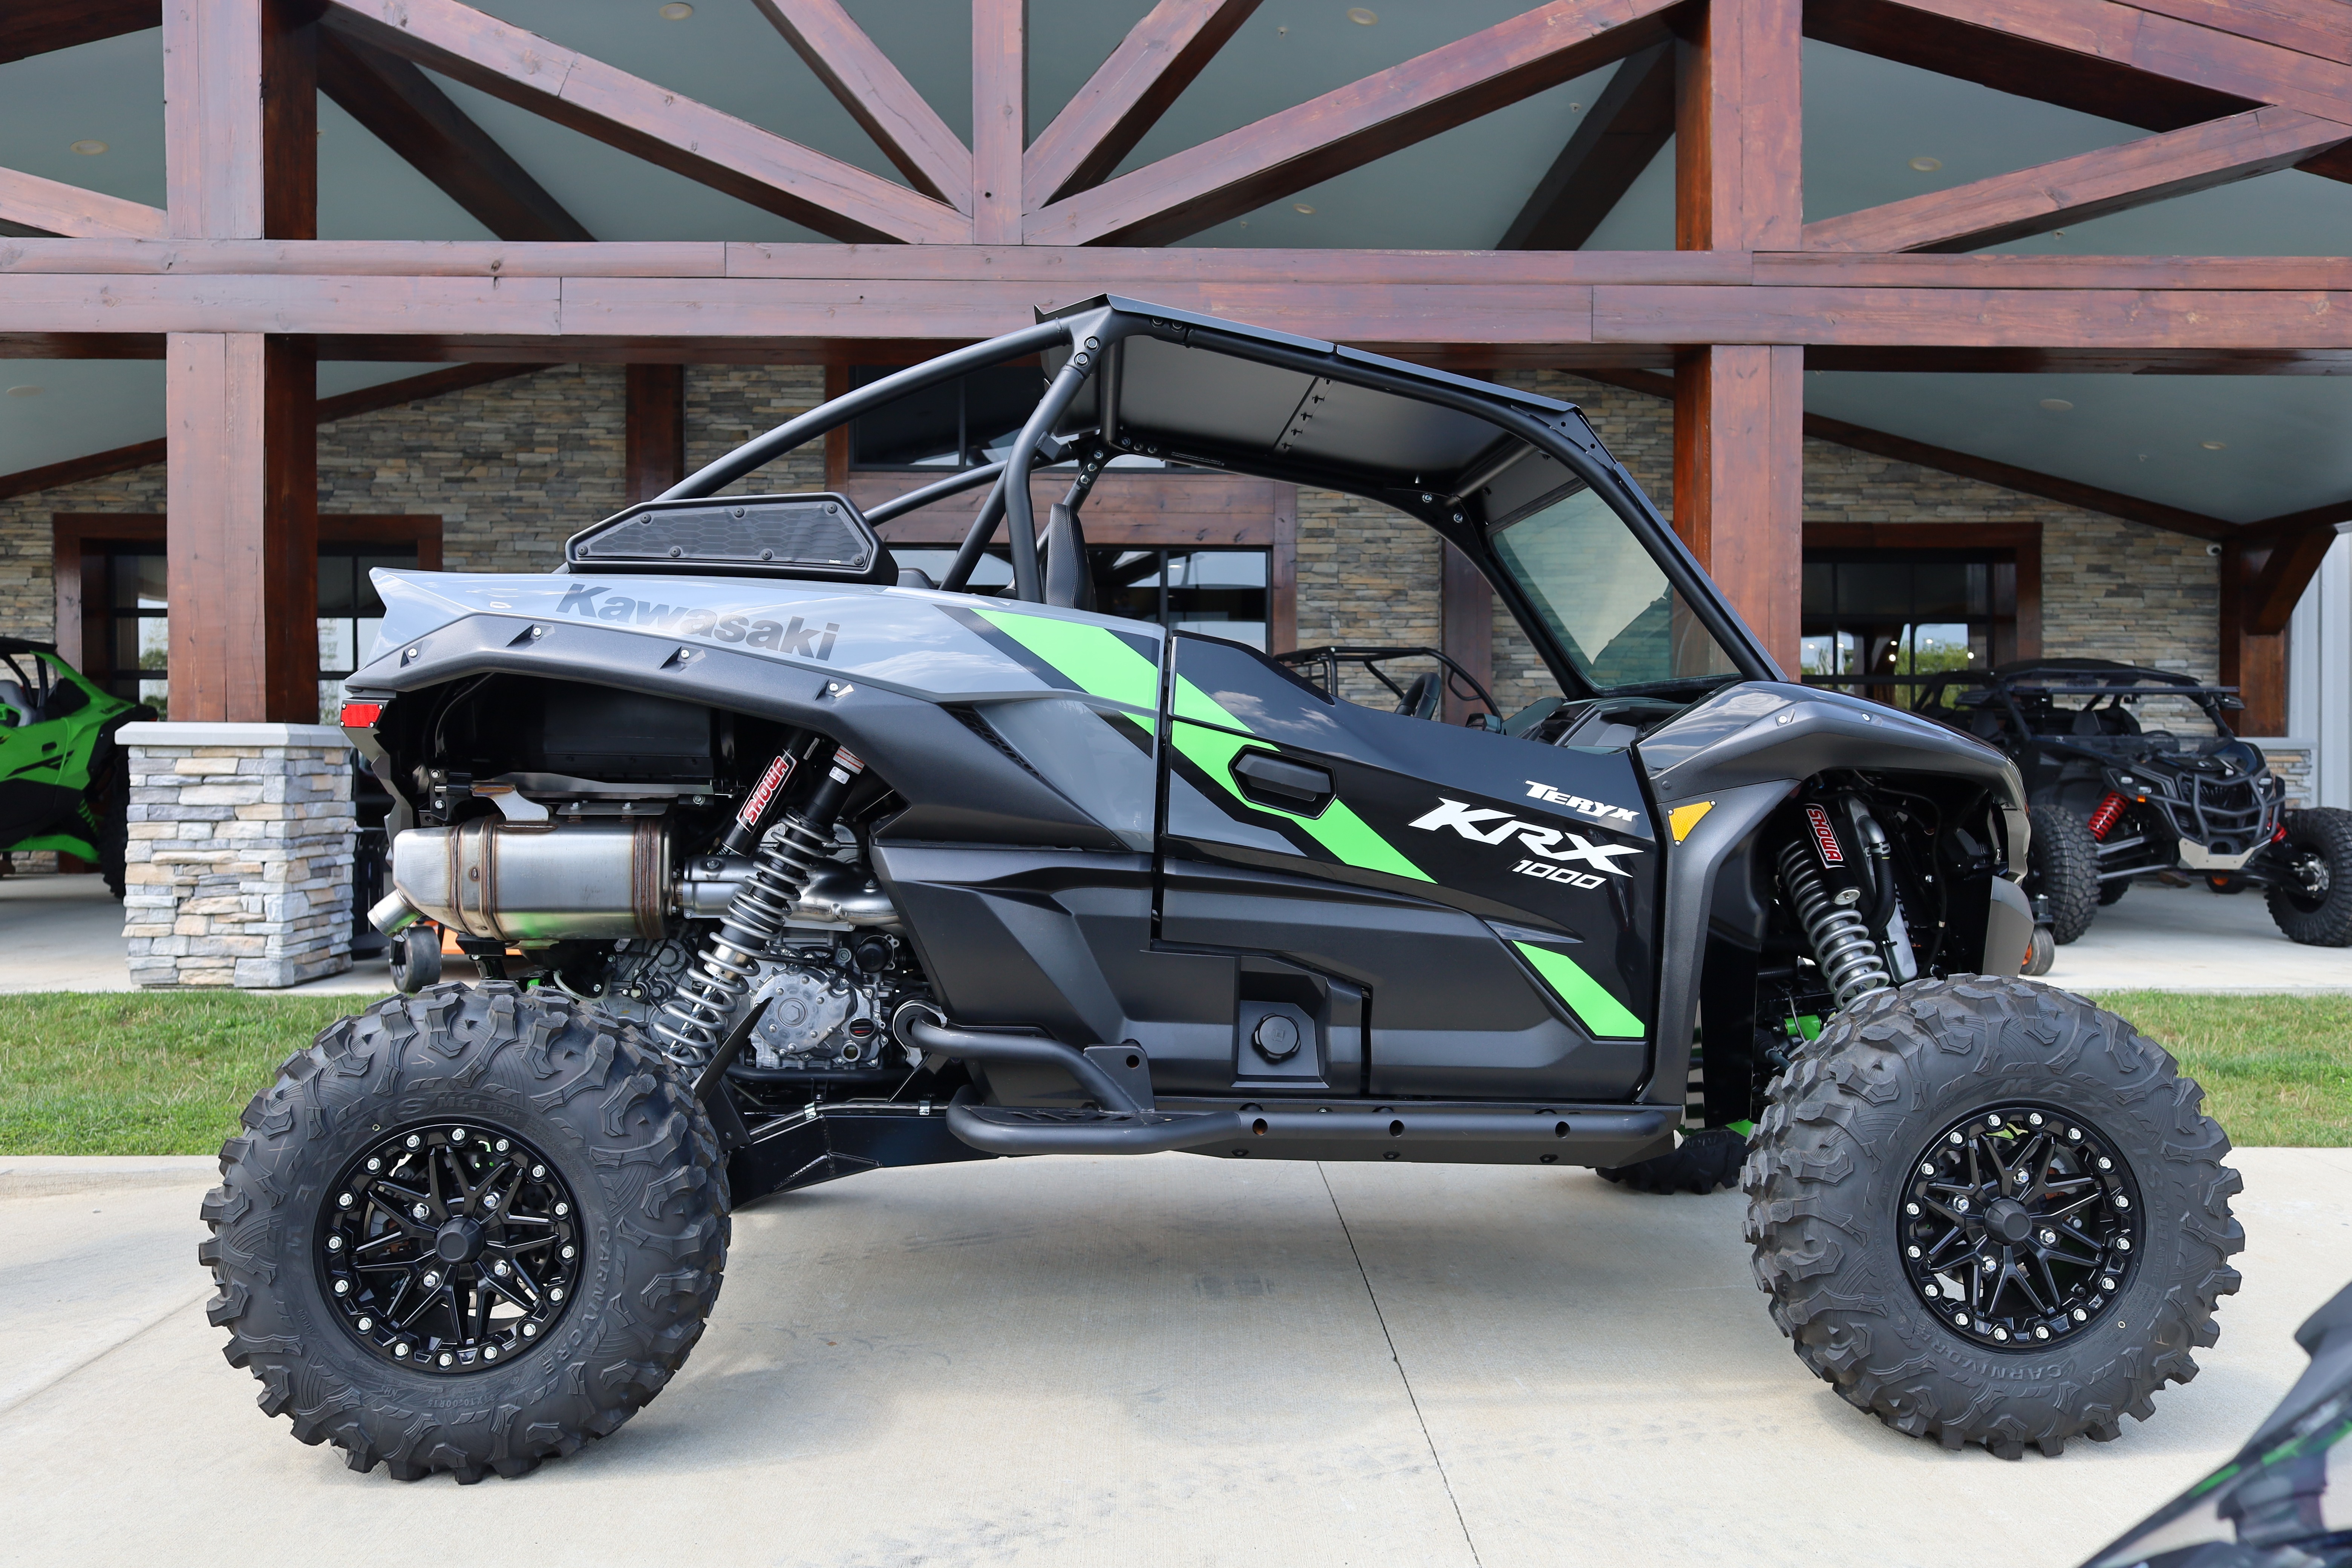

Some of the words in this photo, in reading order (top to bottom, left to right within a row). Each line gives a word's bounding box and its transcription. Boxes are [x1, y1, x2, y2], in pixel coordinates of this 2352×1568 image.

[556, 583, 840, 661] Kawasaki
[743, 755, 789, 827] SHOWA
[1525, 779, 1641, 822] TERYX
[1407, 796, 1645, 878] KRX
[1806, 808, 1844, 862] SHOWA
[1512, 859, 1607, 890] 1000
[436, 1096, 482, 1110] ML1
[484, 1101, 521, 1122] RADIAL
[1933, 1096, 1956, 1114] NYLON
[2154, 1198, 2168, 1242] ML1
[296, 1308, 316, 1334] NYLON
[539, 1225, 611, 1375] CARNIVORE
[537, 1349, 554, 1364] 2025
[1916, 1326, 2063, 1380] CARNIVORE
[378, 1384, 398, 1398] NHS
